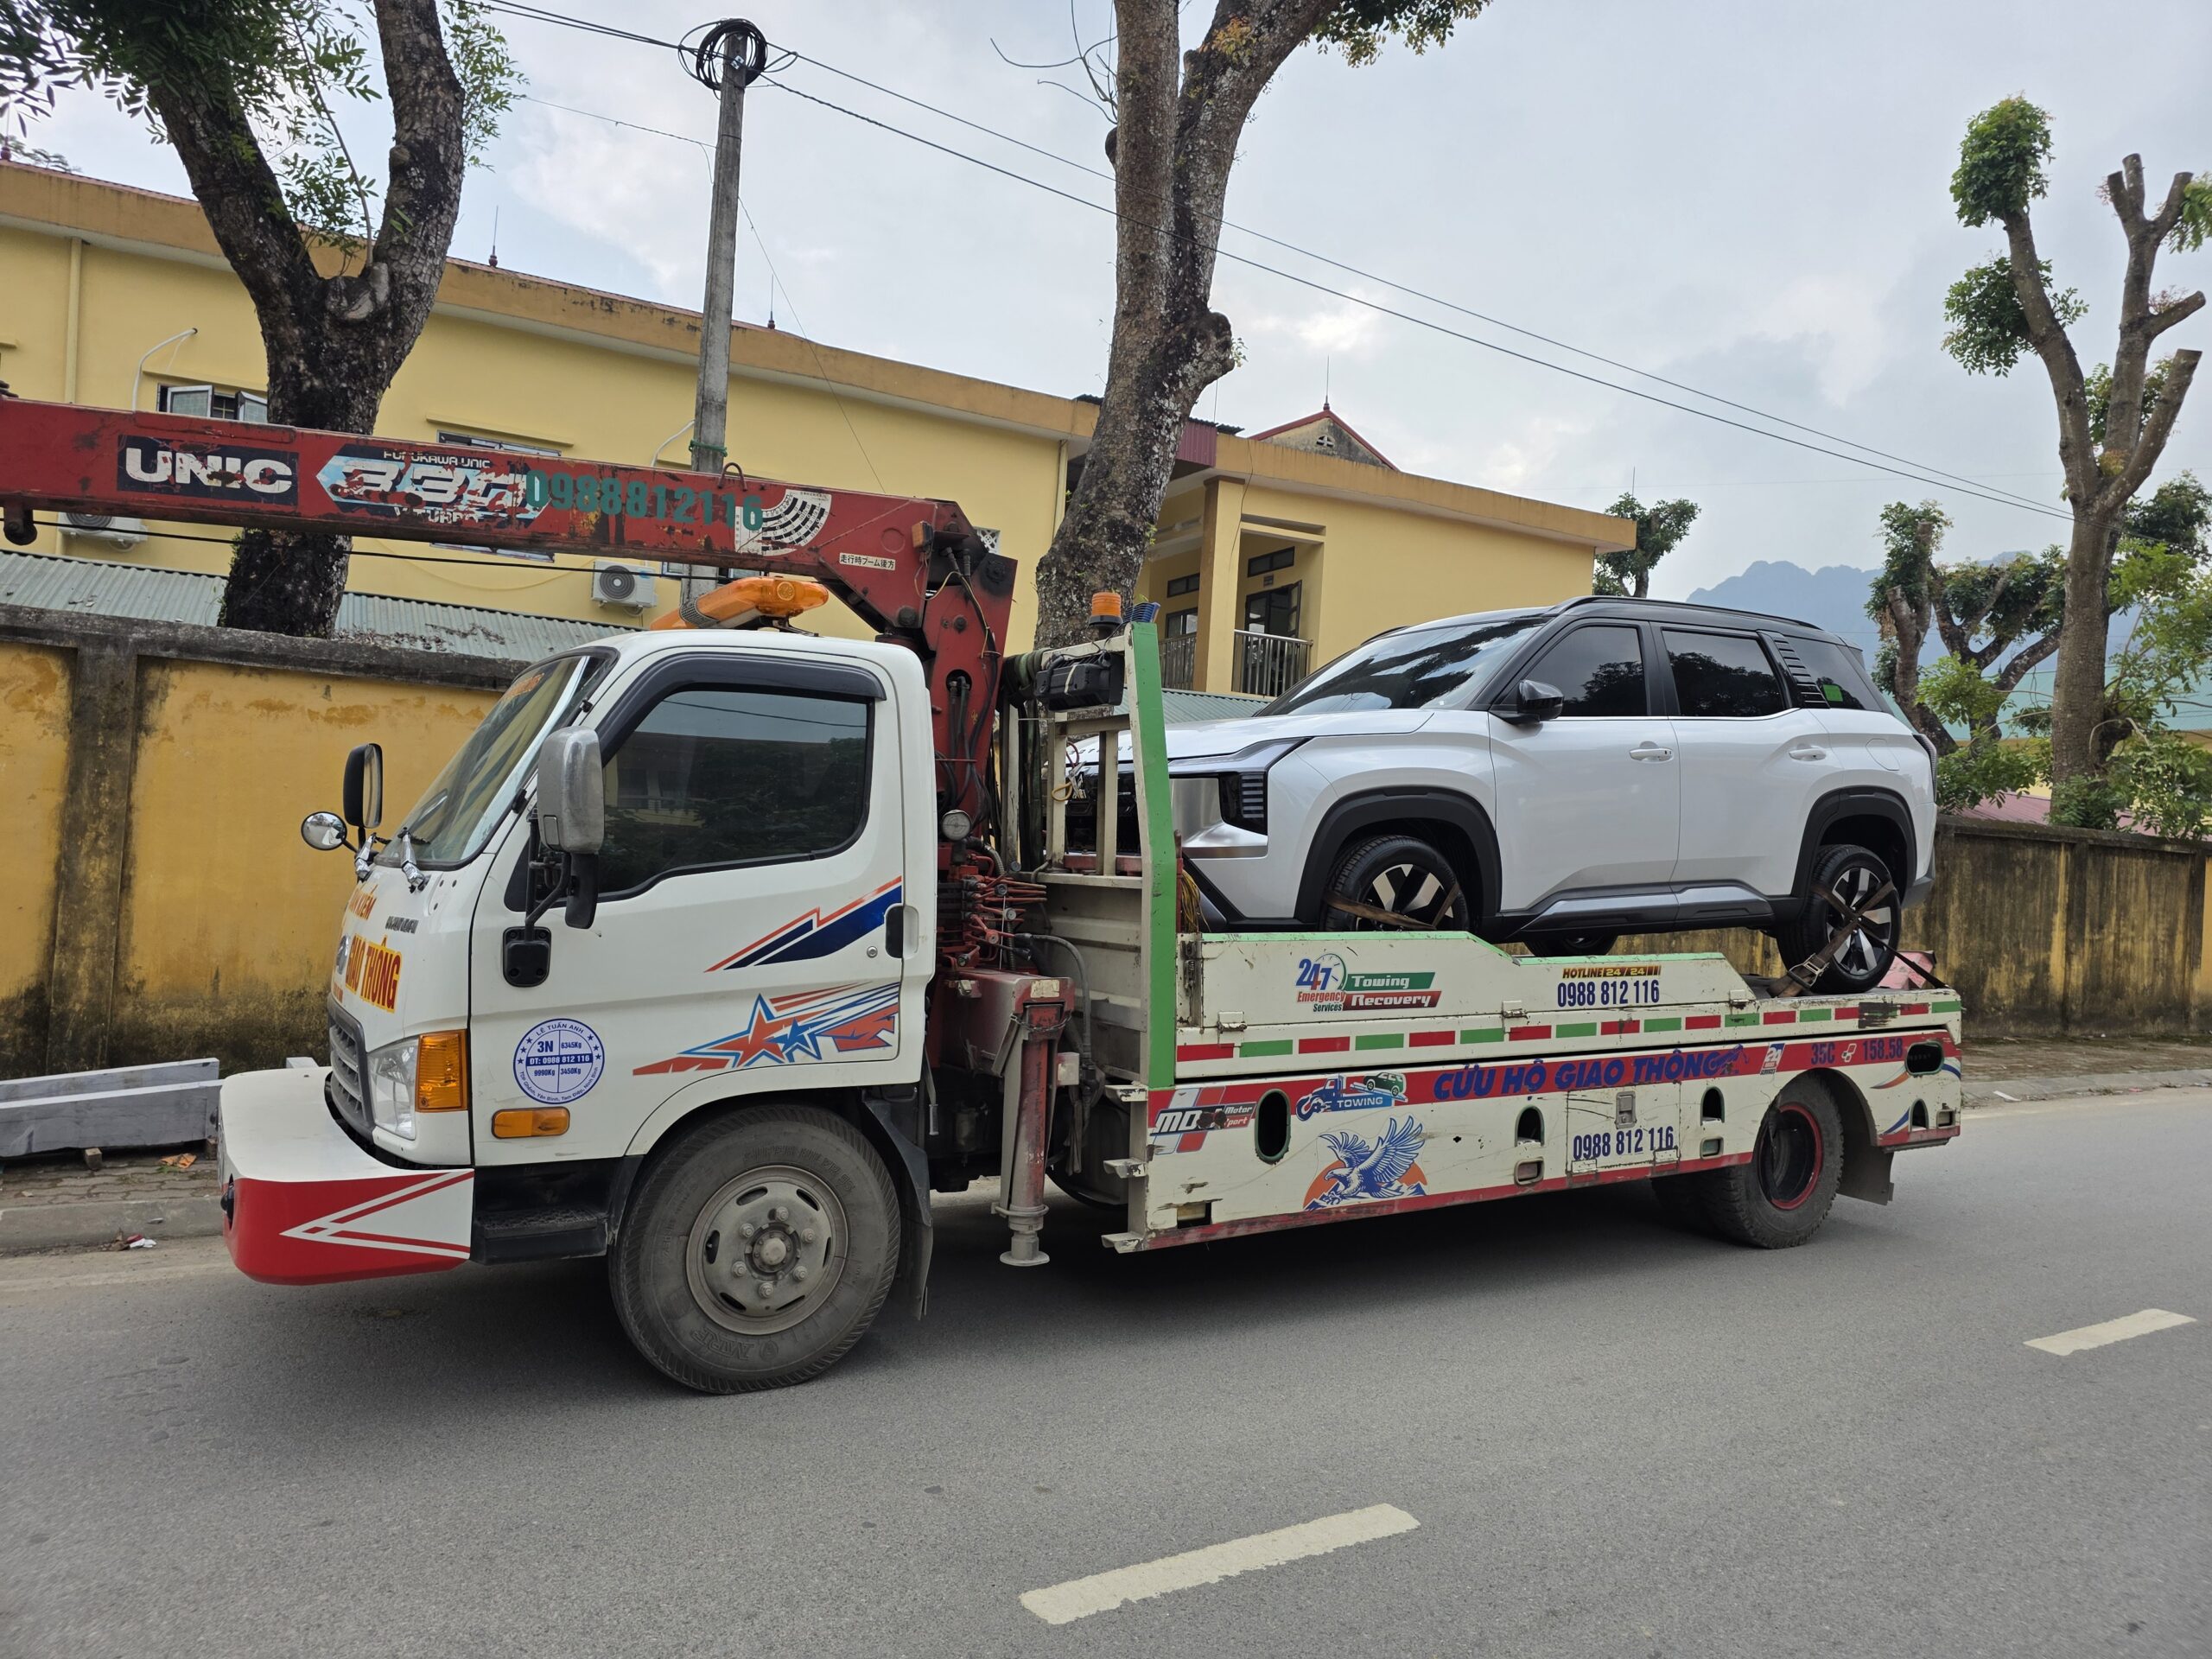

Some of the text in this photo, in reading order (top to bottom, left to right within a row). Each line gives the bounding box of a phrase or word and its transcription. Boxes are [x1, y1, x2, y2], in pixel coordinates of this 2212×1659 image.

[461, 457, 490, 468] UNIC
[126, 448, 292, 493] UNIC
[525, 469, 764, 531] 0988812116
[841, 554, 895, 569] 走行時ブーム後方
[360, 934, 403, 1013] THÔNG
[1562, 968, 1604, 978] HOTLINE
[1351, 975, 1410, 989] Towing
[1297, 991, 1346, 1003] Emergency
[1557, 979, 1660, 1007] 0988 812 116
[1313, 1002, 1343, 1012] Services
[1351, 994, 1432, 1007] Recovery
[569, 1025, 584, 1034] ANH
[537, 1040, 553, 1052] 3N
[1810, 1041, 1836, 1065] 35C
[1433, 1047, 1725, 1101] CỨU HỘ GIAO THÔNG
[1337, 1096, 1383, 1108] TOWING
[1153, 1109, 1224, 1133] MD
[1573, 1126, 1674, 1160] 0988 812 116
